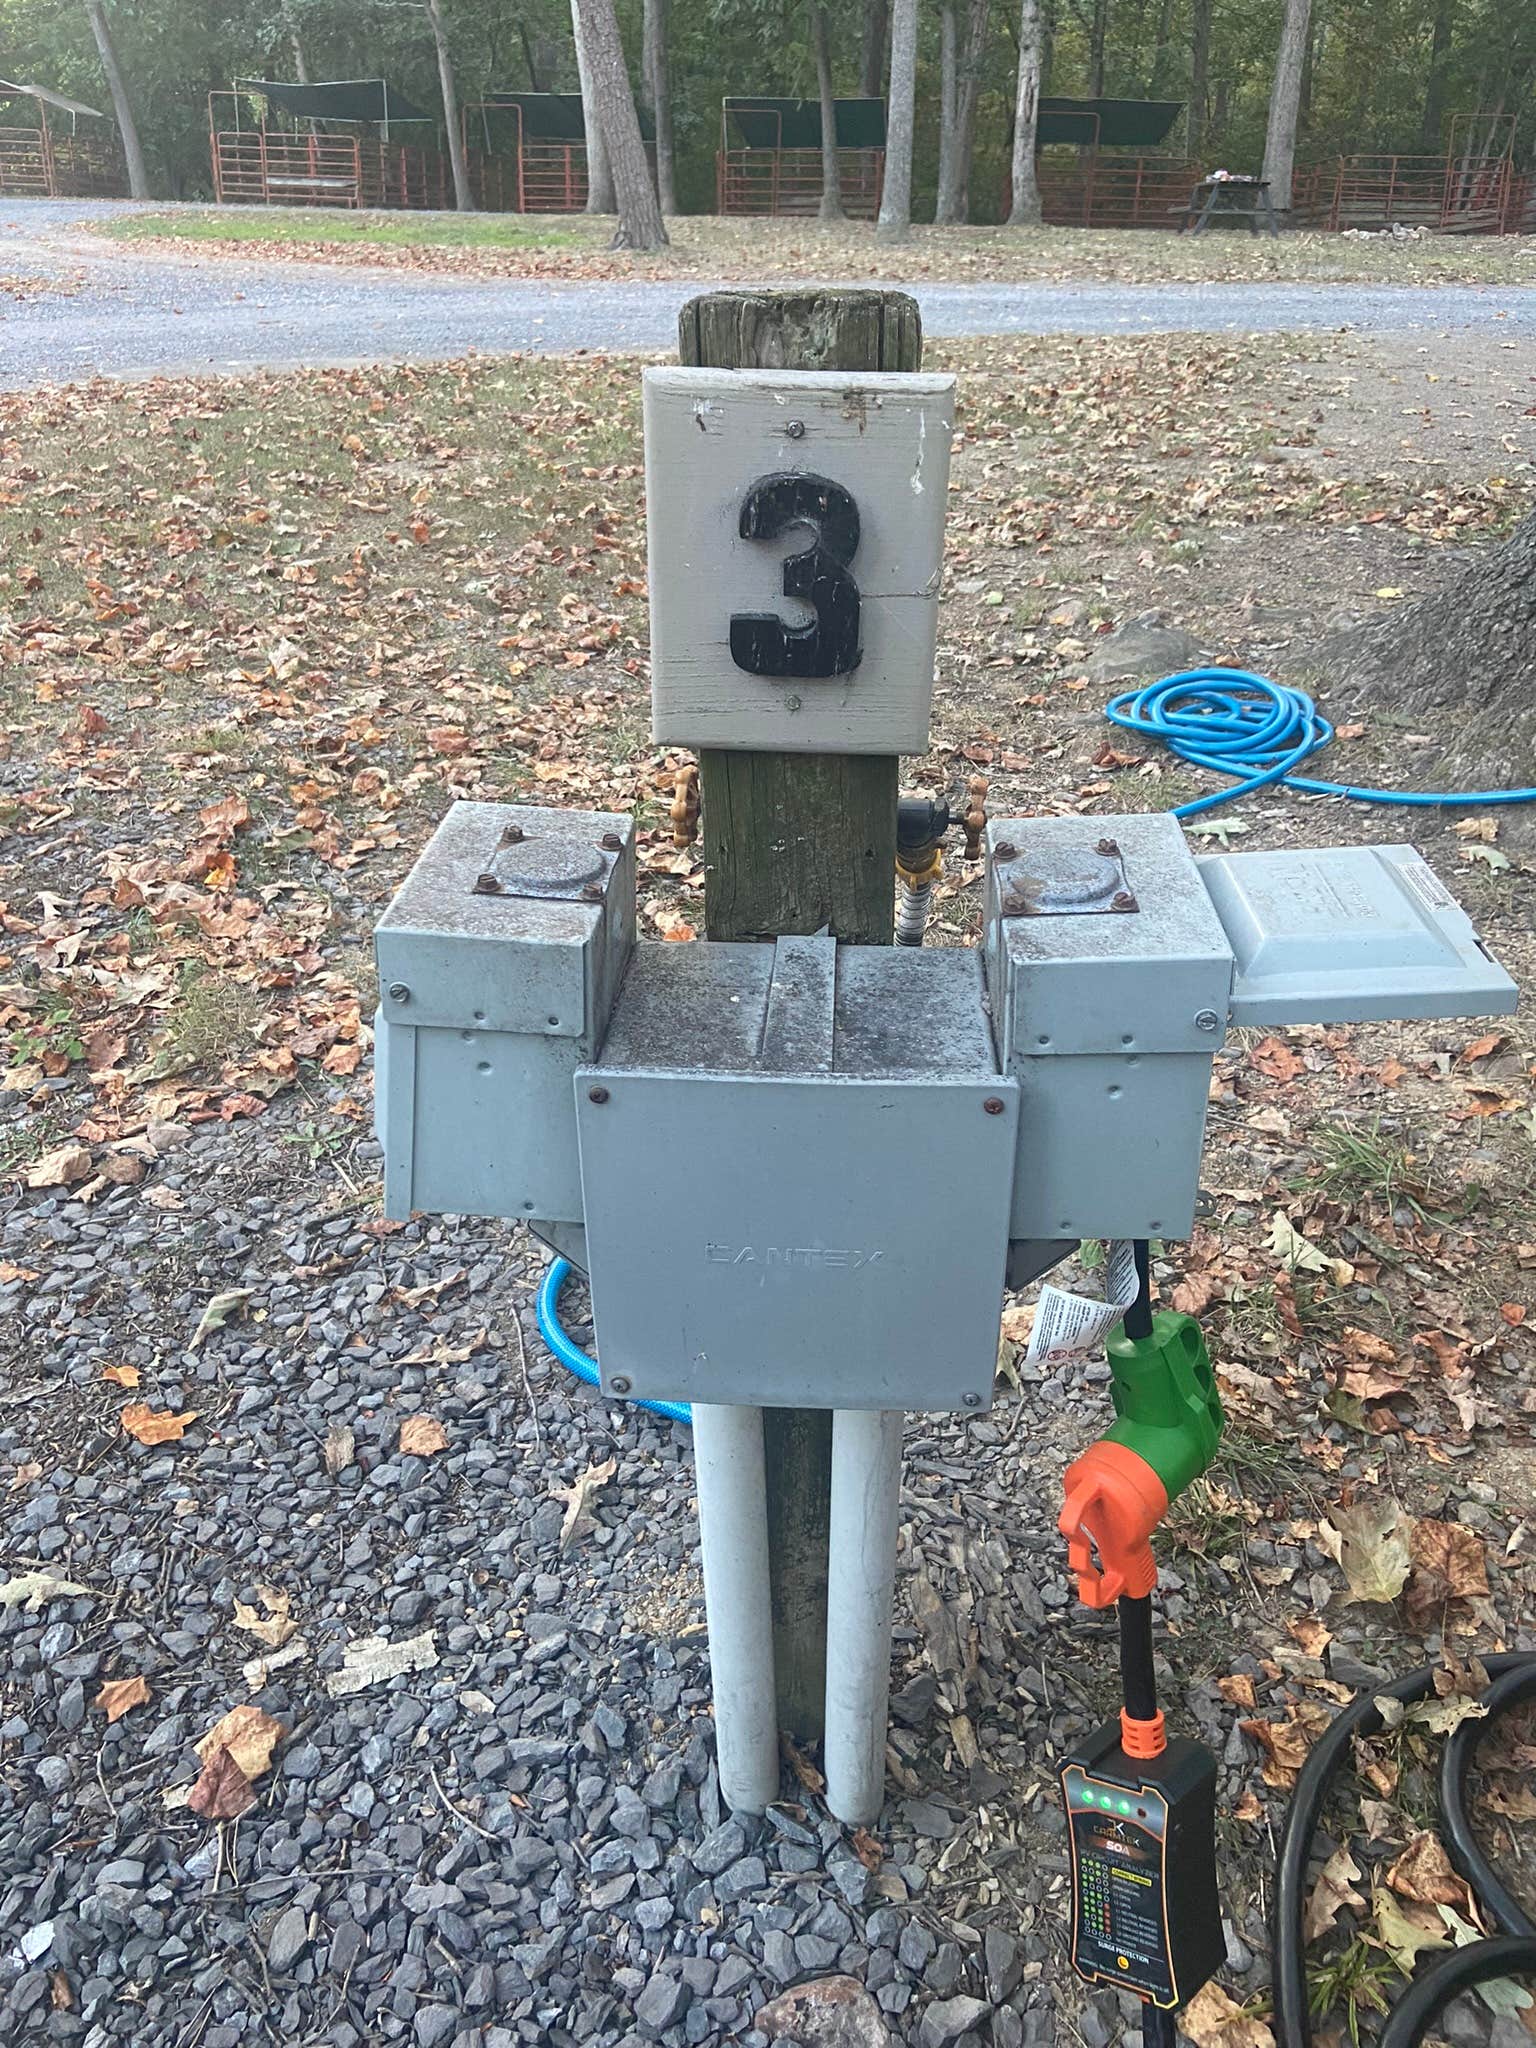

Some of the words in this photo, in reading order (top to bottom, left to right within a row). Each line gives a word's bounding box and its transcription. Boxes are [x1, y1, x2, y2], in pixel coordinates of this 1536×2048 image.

[730, 472, 863, 677] 3
[705, 1245, 884, 1269] CANTEX
[1115, 1947, 1150, 1965] PROTECTION
